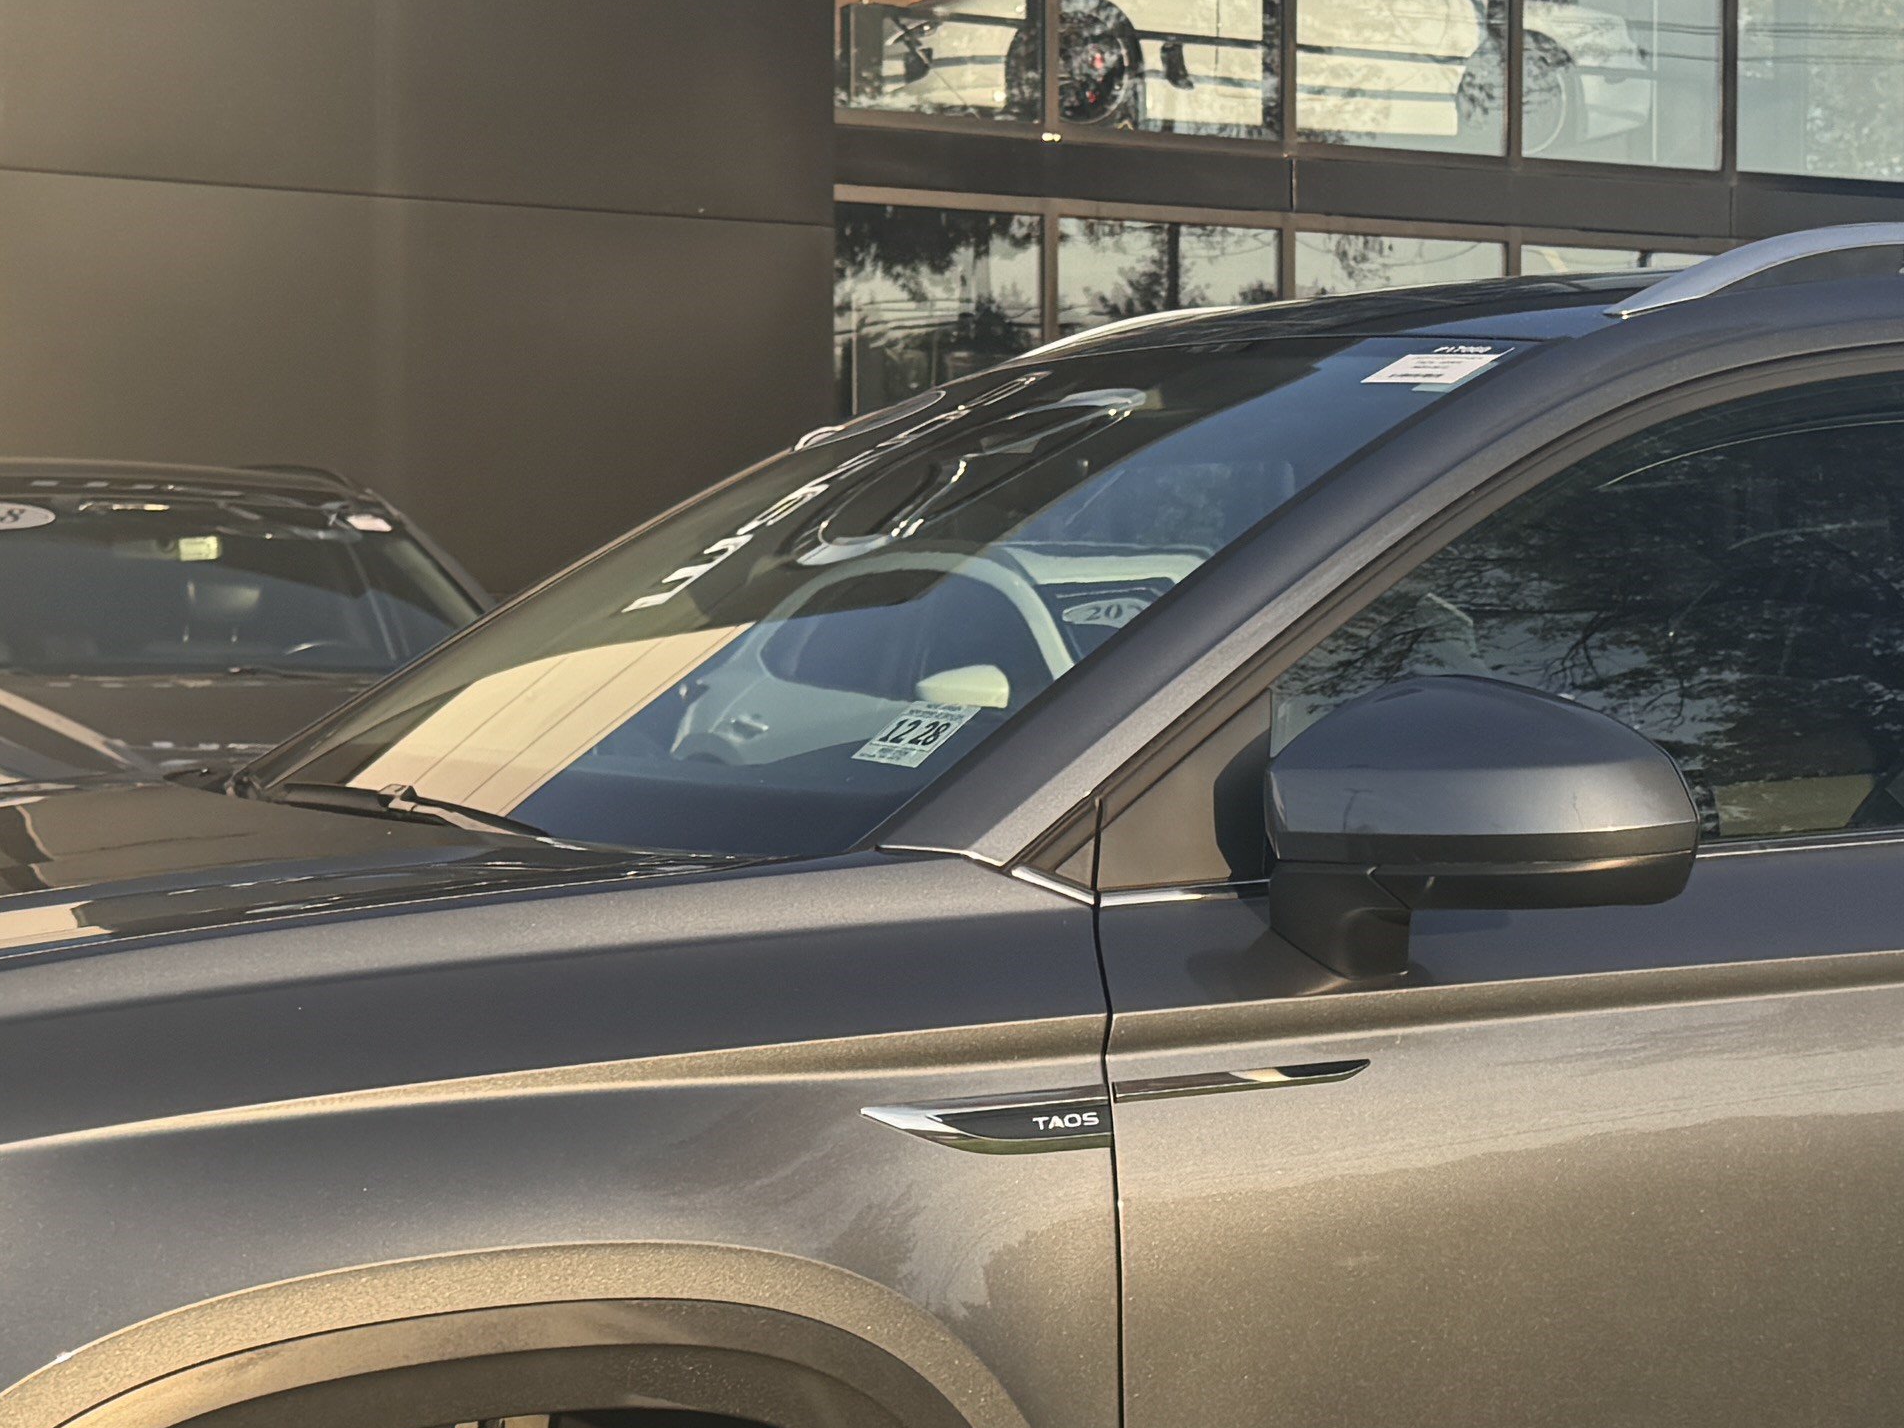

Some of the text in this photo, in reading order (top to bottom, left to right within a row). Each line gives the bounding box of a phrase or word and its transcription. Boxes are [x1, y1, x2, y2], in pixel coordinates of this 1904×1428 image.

[1085, 603, 1143, 622] 20
[878, 718, 951, 746] 12 28
[1032, 1112, 1099, 1130] TAOS
